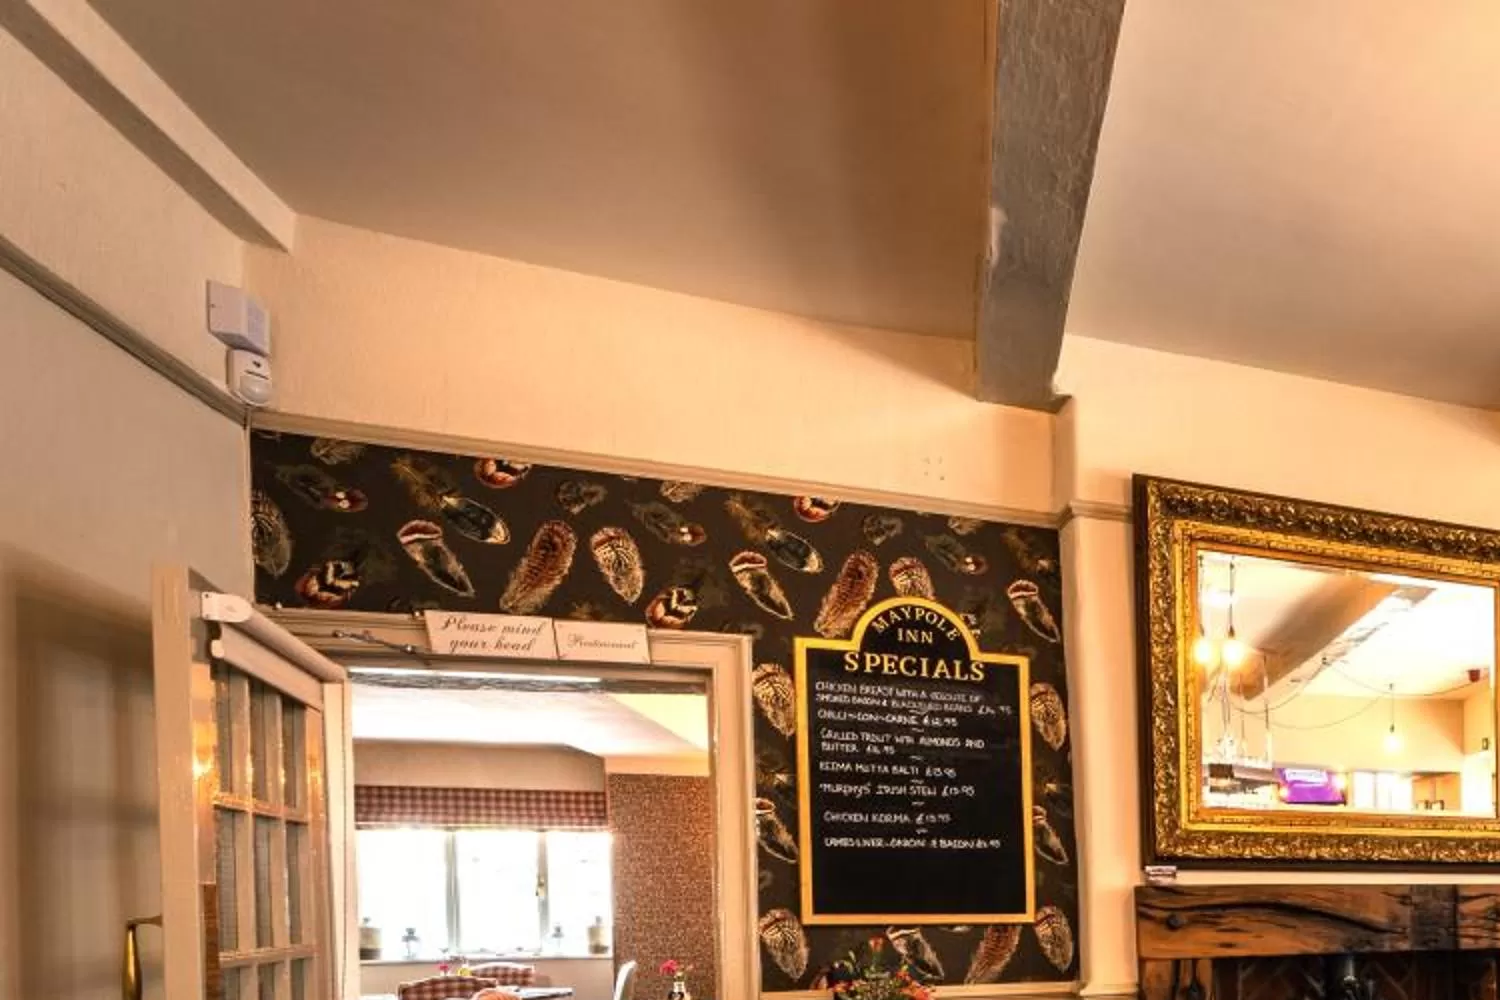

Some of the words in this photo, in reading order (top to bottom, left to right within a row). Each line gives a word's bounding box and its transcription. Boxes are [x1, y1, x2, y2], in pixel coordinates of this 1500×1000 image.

[441, 615, 496, 633] Please
[501, 619, 546, 635] mind
[871, 605, 961, 642] MAYPOLE
[449, 638, 488, 654] your
[493, 635, 534, 652] head
[897, 627, 934, 644] INN
[844, 651, 986, 682] SPECIALS
